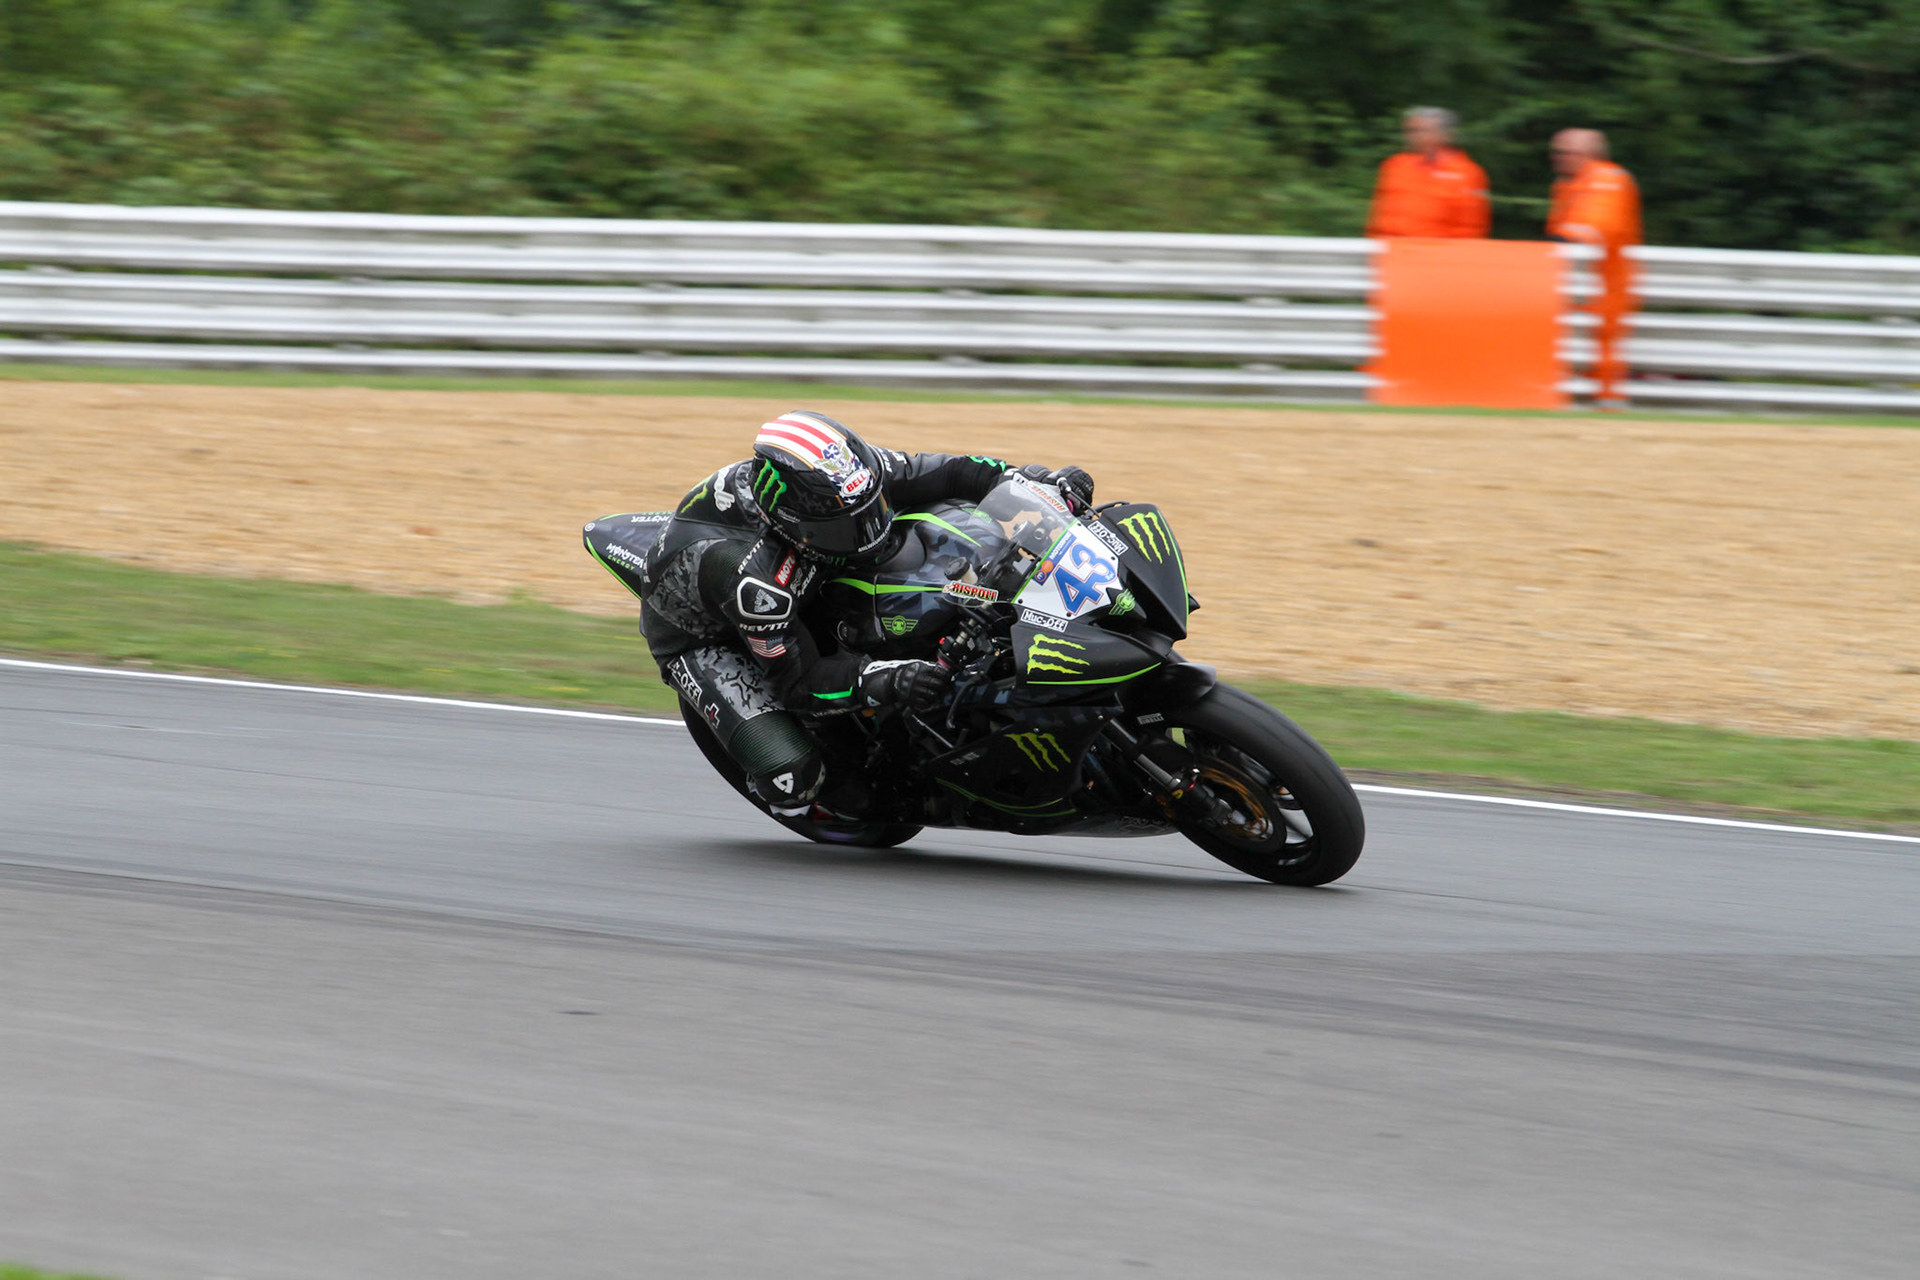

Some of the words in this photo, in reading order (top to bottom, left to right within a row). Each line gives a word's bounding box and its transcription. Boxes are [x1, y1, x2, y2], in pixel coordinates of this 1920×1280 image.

[822, 443, 840, 460] 43
[845, 472, 868, 493] BELL
[1089, 523, 1126, 554] Muc-Off
[606, 543, 645, 568] MONSTER
[607, 554, 635, 571] ENERGY
[1051, 542, 1118, 616] 43
[953, 583, 997, 601] RISPOLI
[1023, 610, 1068, 631] Muc-Off
